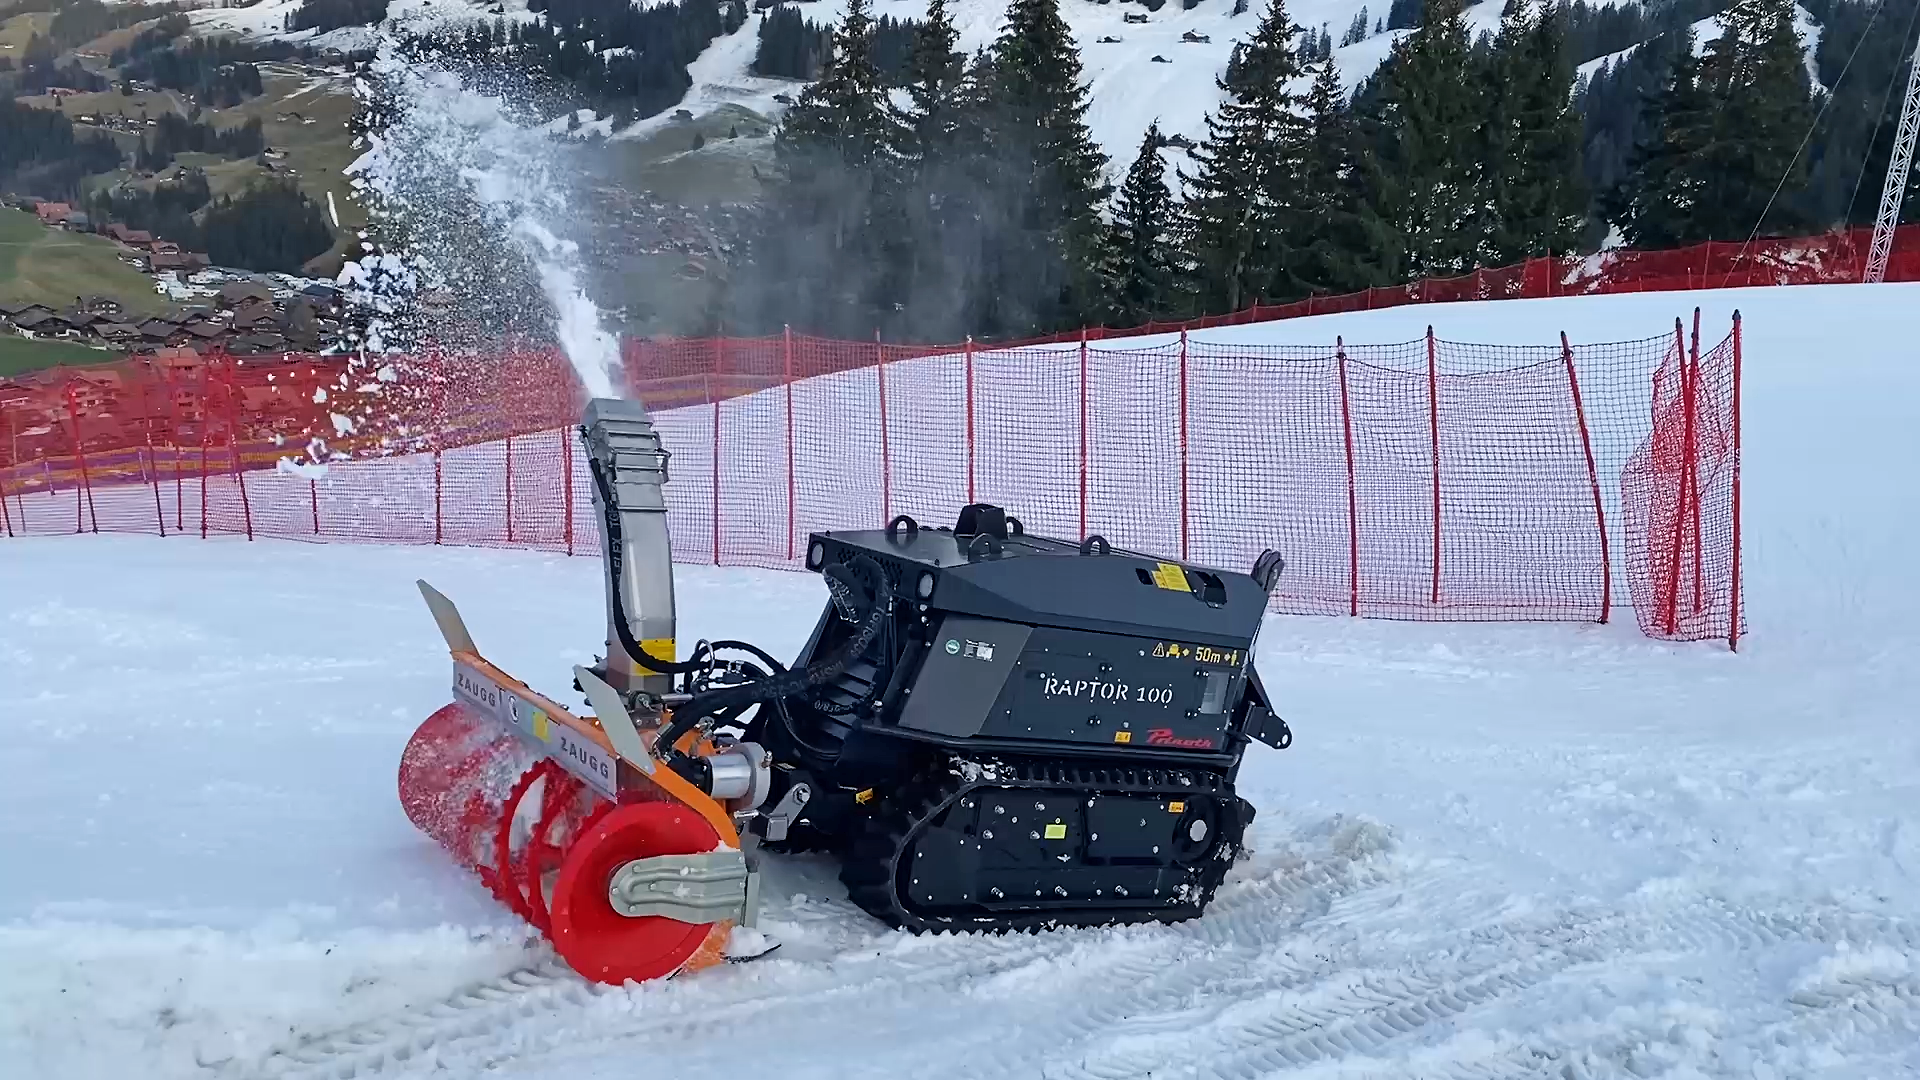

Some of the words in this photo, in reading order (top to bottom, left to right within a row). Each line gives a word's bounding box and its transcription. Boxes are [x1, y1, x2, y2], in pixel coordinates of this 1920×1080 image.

[1195, 646, 1221, 664] 50m
[457, 673, 496, 707] ZAUGG
[1044, 677, 1129, 702] RAPTOR
[1136, 686, 1173, 704] 100
[560, 736, 609, 780] ZAUGG
